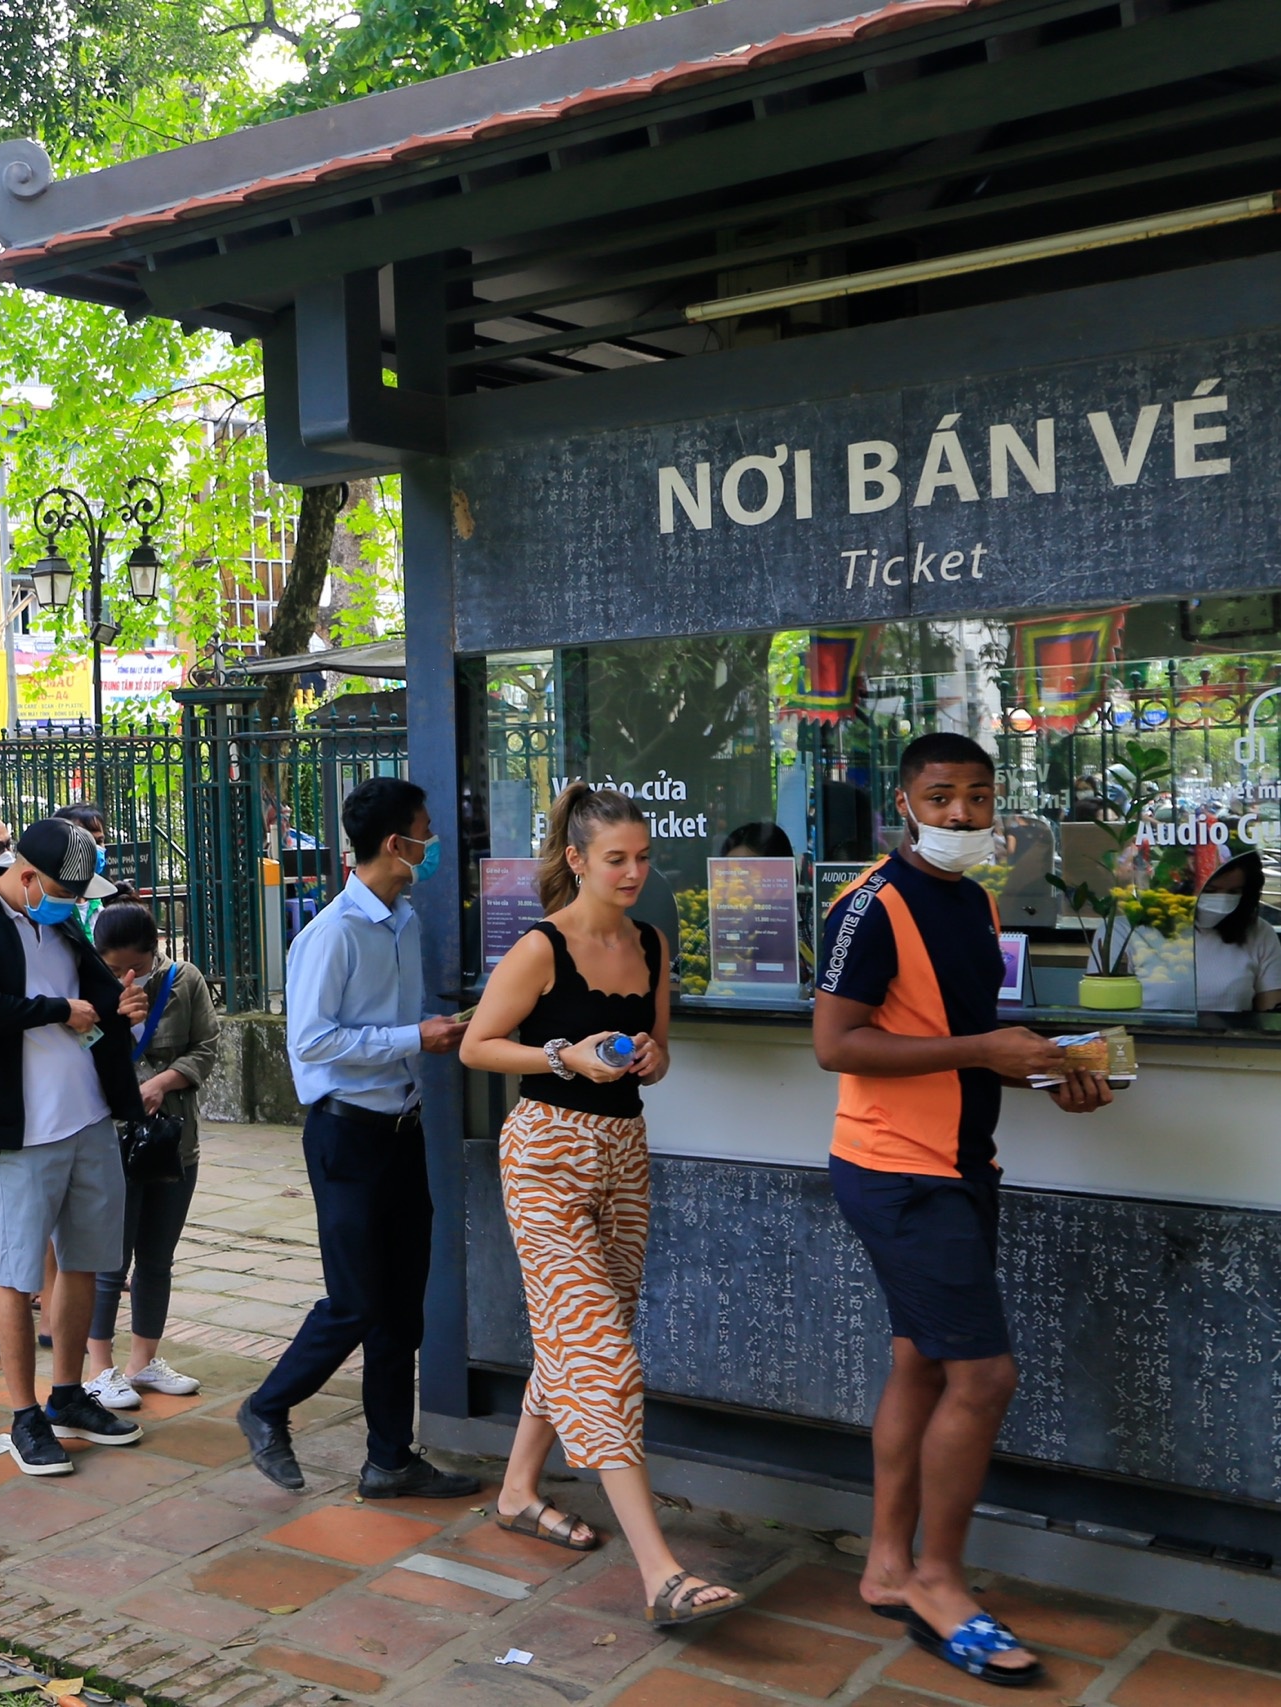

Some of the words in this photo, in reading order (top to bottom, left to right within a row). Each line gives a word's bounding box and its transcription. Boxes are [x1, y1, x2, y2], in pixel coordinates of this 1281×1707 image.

[658, 444, 812, 533] NƠI
[848, 413, 1058, 515] BÁN
[1088, 378, 1231, 485] VÉ
[839, 541, 987, 589] Ticket
[641, 769, 687, 800] cửa
[1136, 813, 1229, 845] Audio
[822, 872, 846, 882] AUDIO
[821, 914, 860, 992] LACOSTE
